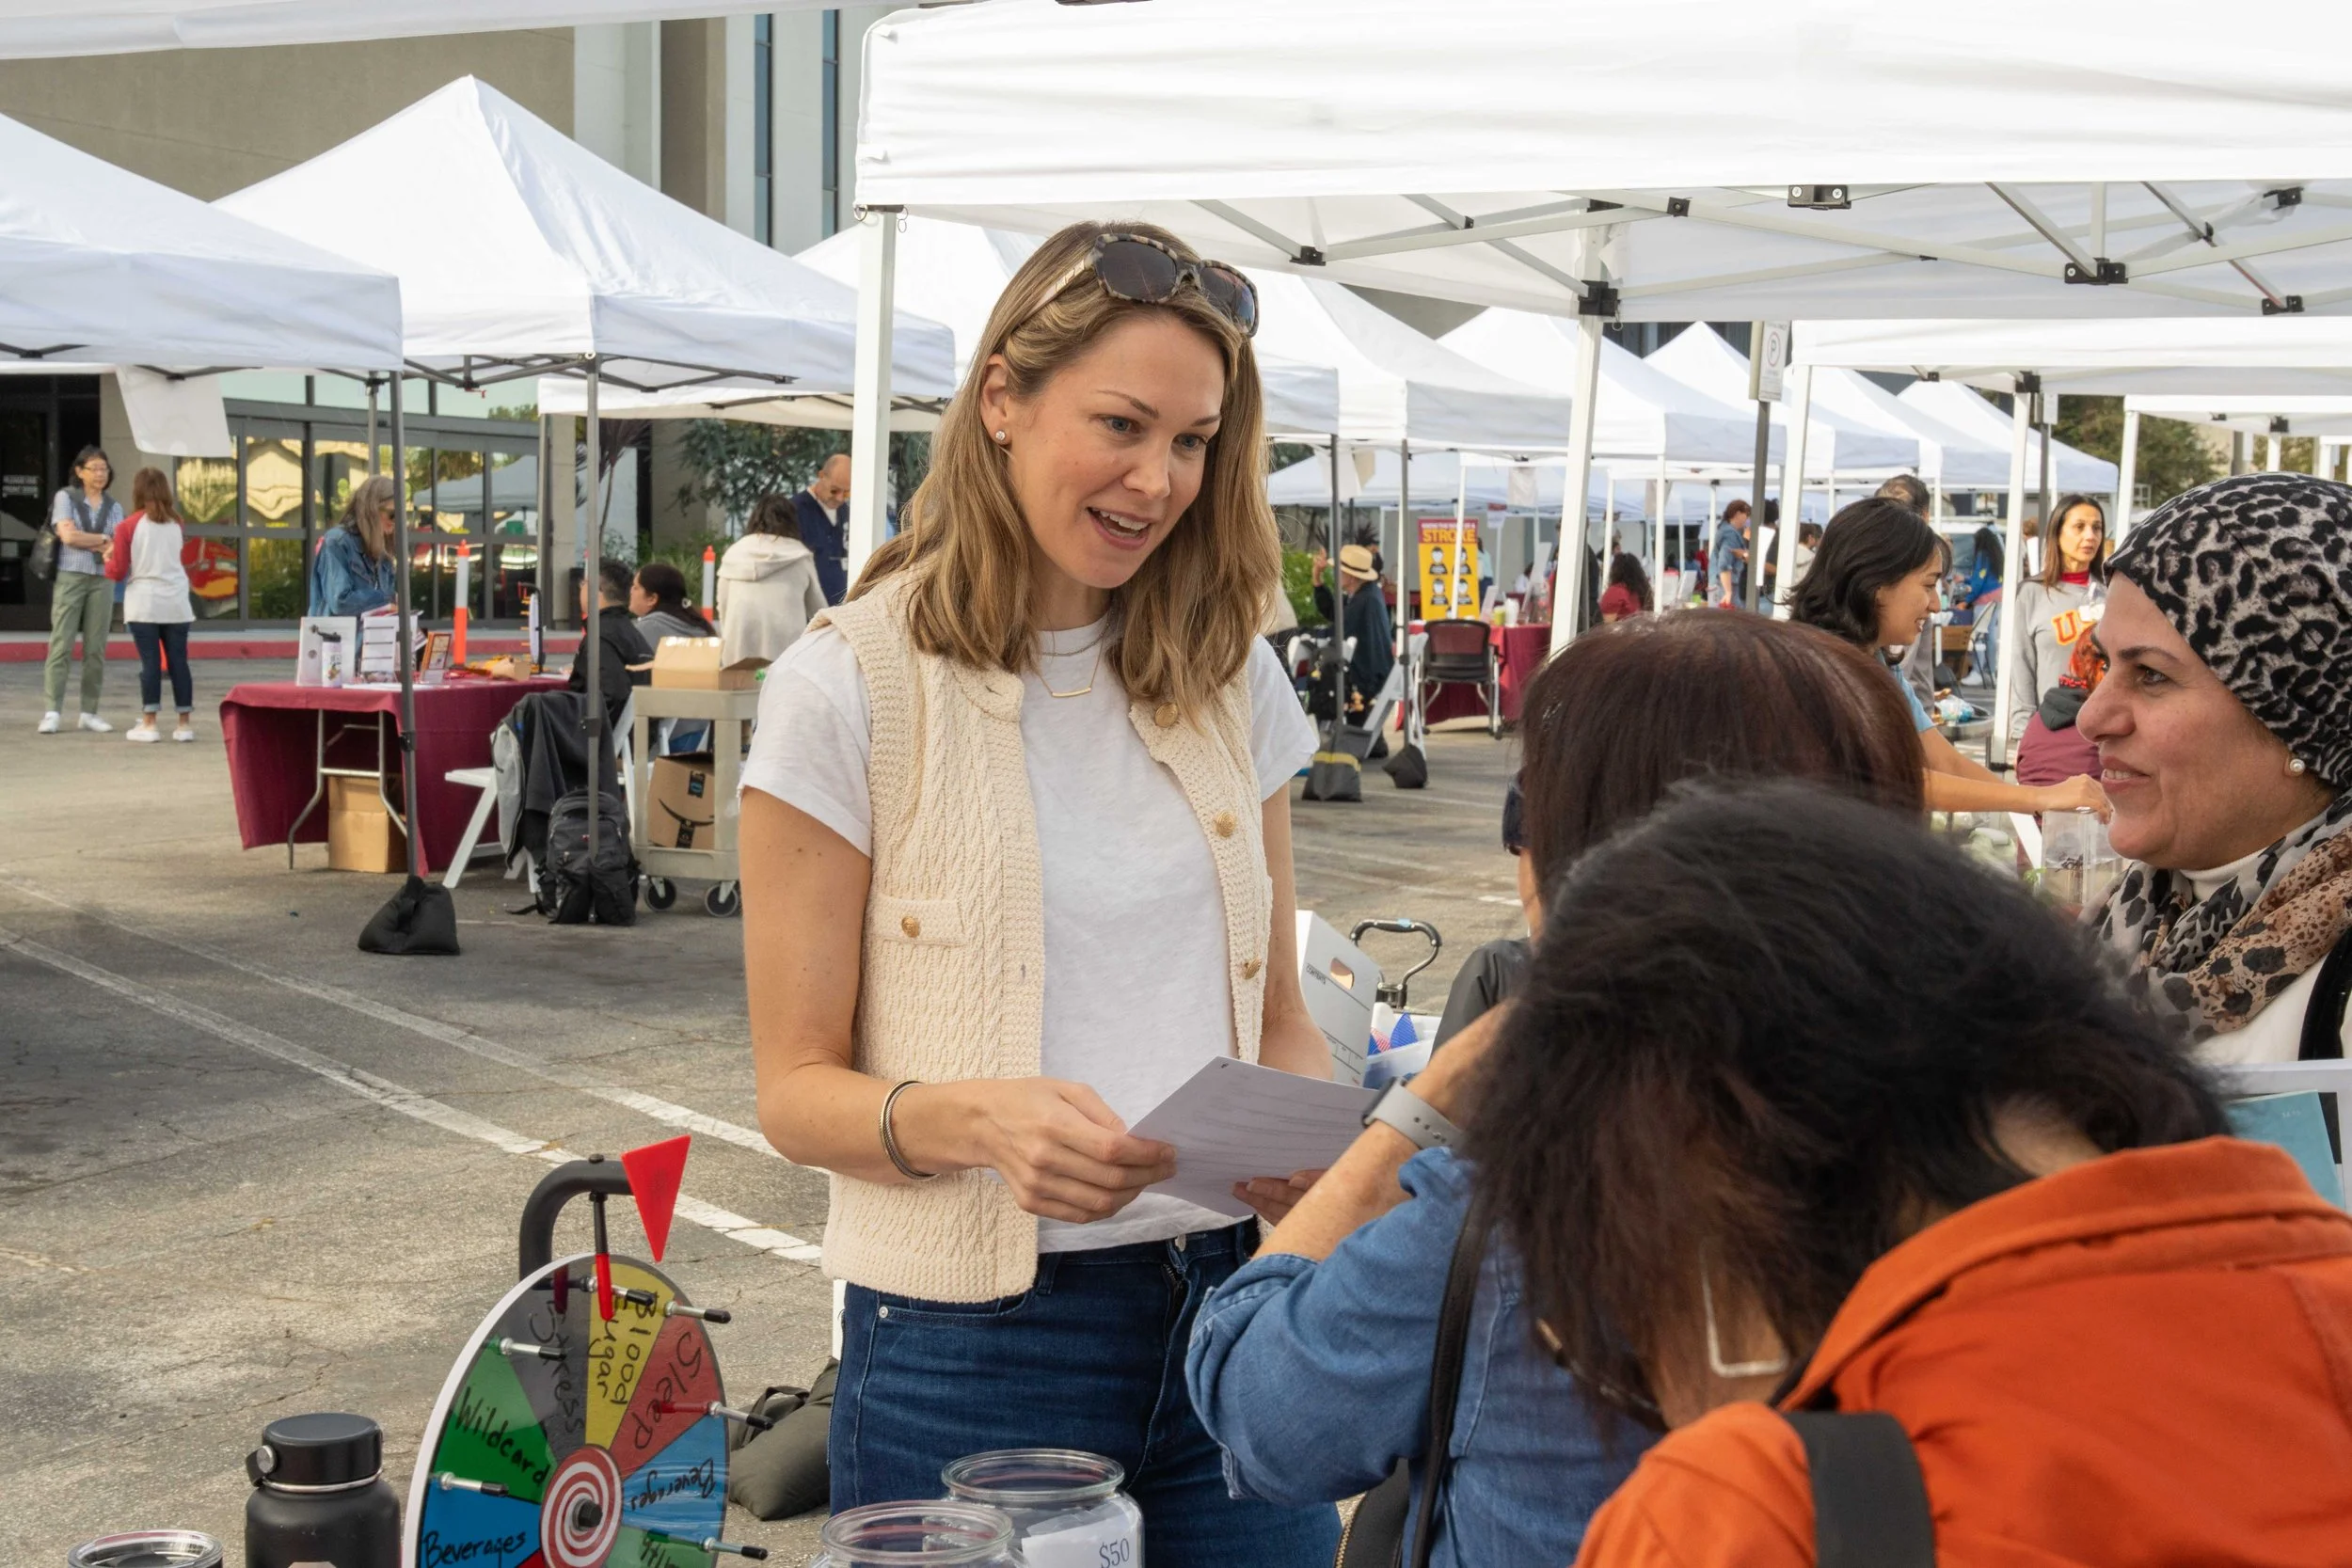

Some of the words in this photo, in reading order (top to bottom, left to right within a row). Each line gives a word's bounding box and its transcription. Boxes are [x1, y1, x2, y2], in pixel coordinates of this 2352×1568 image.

[611, 1290, 660, 1404] Blood
[634, 1331, 702, 1449] Sleep
[455, 1386, 551, 1487] Wildcard
[629, 1457, 716, 1513] Beverages
[423, 1530, 526, 1568] Beverages
[1099, 1539, 1129, 1568] $50
